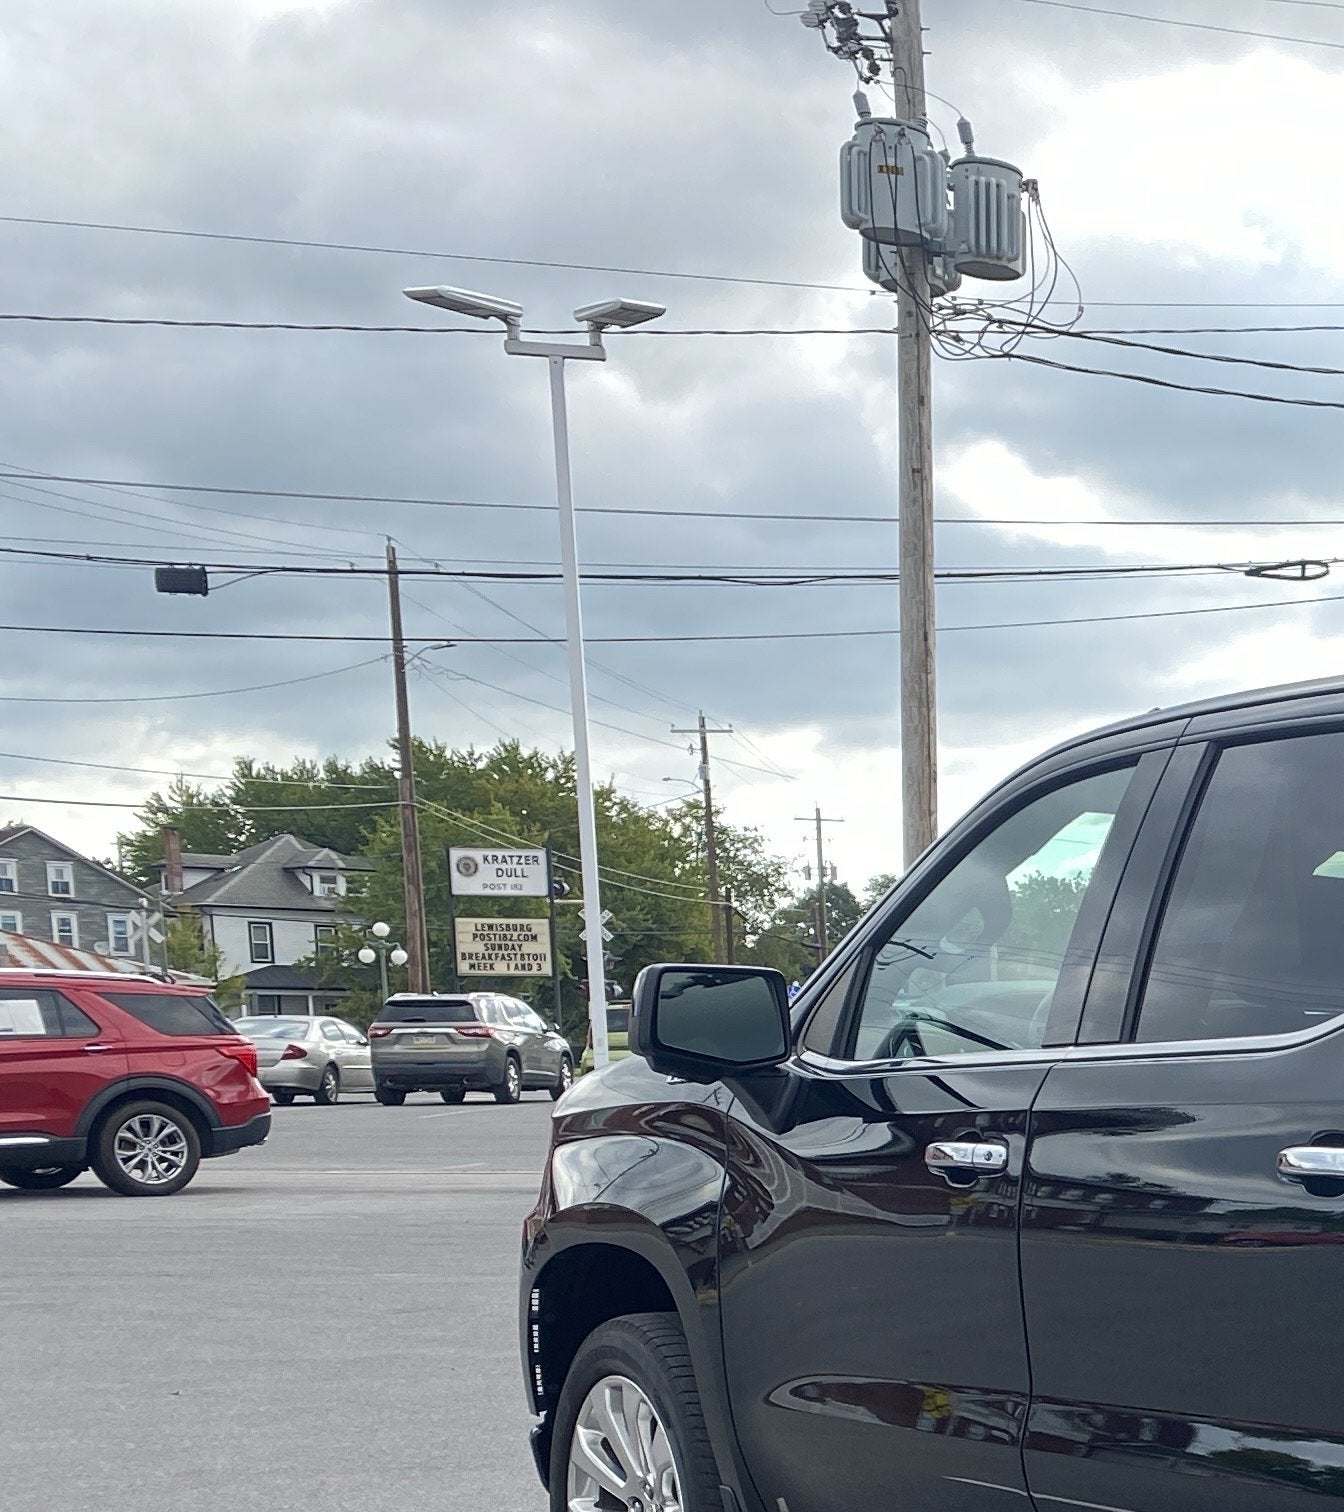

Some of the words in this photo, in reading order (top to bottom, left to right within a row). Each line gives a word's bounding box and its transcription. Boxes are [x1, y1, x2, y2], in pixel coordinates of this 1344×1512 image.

[482, 854, 540, 866] KRATZER
[495, 868, 528, 878] DULL
[482, 882, 507, 891] POST
[474, 922, 533, 932] LEWISBURG
[483, 942, 523, 952] SUNDAY
[468, 962, 495, 971] WEEK
[513, 962, 533, 972] AND
[536, 962, 543, 972] 3
